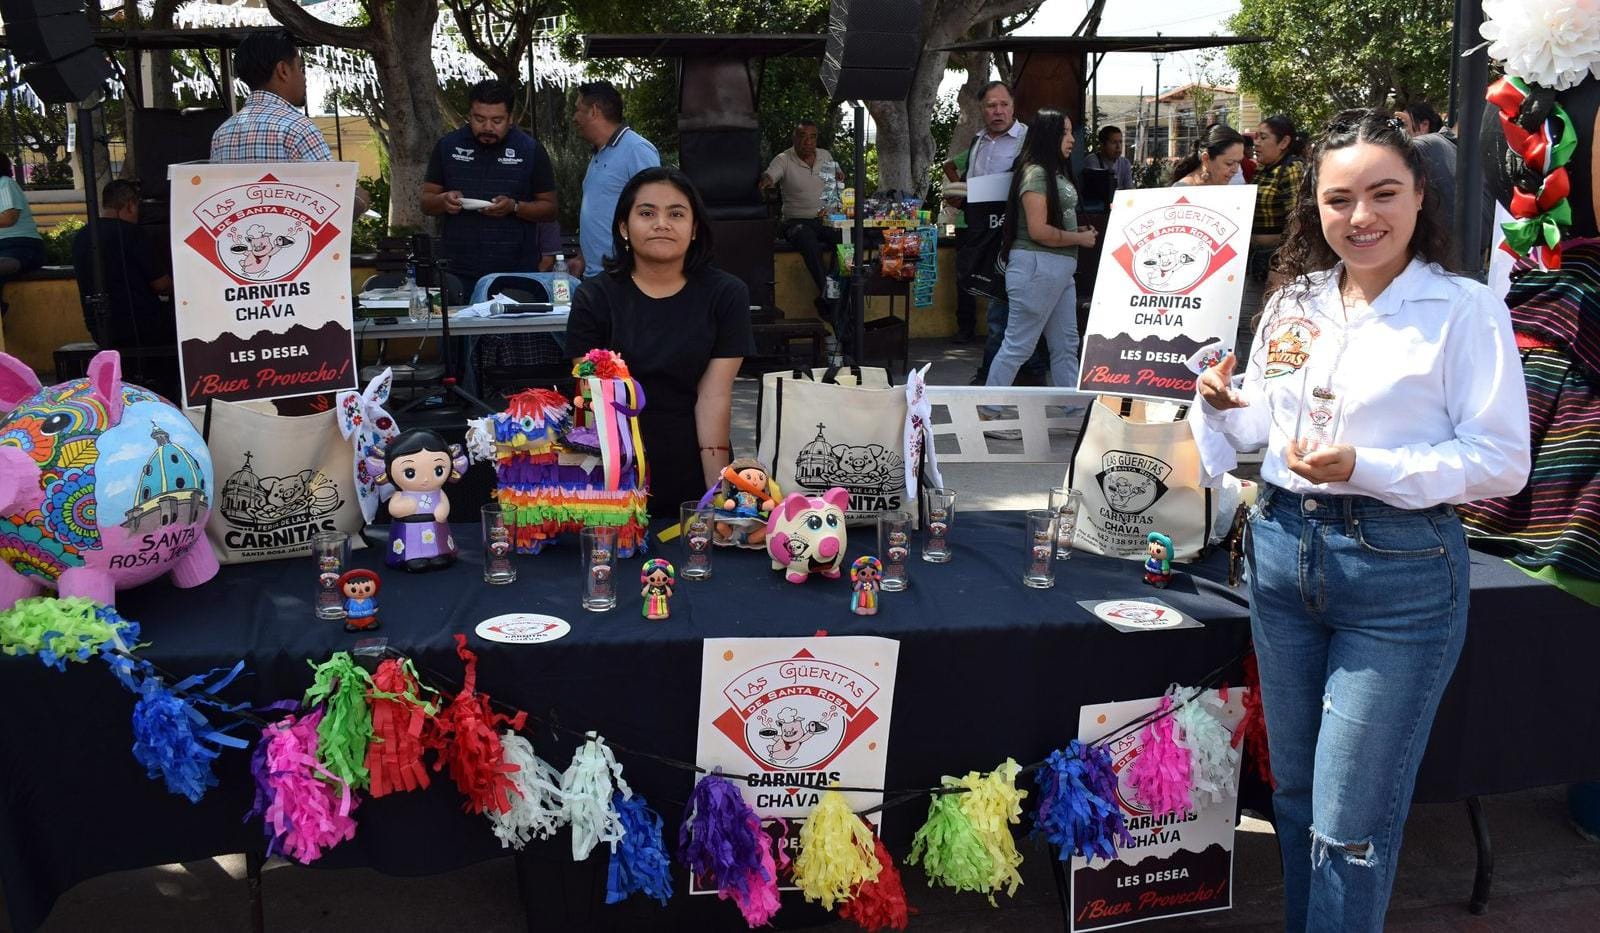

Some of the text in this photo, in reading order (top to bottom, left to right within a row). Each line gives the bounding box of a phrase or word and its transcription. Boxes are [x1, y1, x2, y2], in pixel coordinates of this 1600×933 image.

[203, 185, 327, 220] LAS GÜERITAS
[217, 205, 313, 232] DE SANTA ROSA
[1130, 207, 1227, 237] LAS GÜERITAS
[1136, 226, 1213, 248] DE SANTA ROSA
[224, 282, 311, 302] CARNITAS
[235, 304, 296, 321] CHAVA
[1129, 295, 1201, 310] CARNITAS
[1134, 312, 1184, 326] CHAVA
[230, 344, 309, 364] LES DESEA
[1120, 349, 1187, 364] LES DESEA
[256, 359, 350, 386] Provecho!
[1106, 453, 1164, 476] LAS GÜERITAS
[847, 495, 901, 511] NITAS
[257, 522, 279, 532] FERIA
[280, 518, 290, 526] DE
[1099, 507, 1154, 525] CARNITAS
[224, 519, 337, 549] CARNITAS
[1104, 521, 1140, 535] CHAVA
[138, 527, 196, 553] SANTA
[109, 552, 160, 569] ROSA
[241, 550, 265, 558] SANTA
[733, 663, 865, 700] LAS GÜERITAS
[747, 685, 848, 714] DE SANTA ROSA
[1118, 755, 1133, 767] DE
[747, 770, 841, 789] CARNITAS
[756, 793, 820, 808] CHAVA
[1116, 867, 1189, 888] LES DESEA
[1139, 879, 1226, 908] Provecho!
